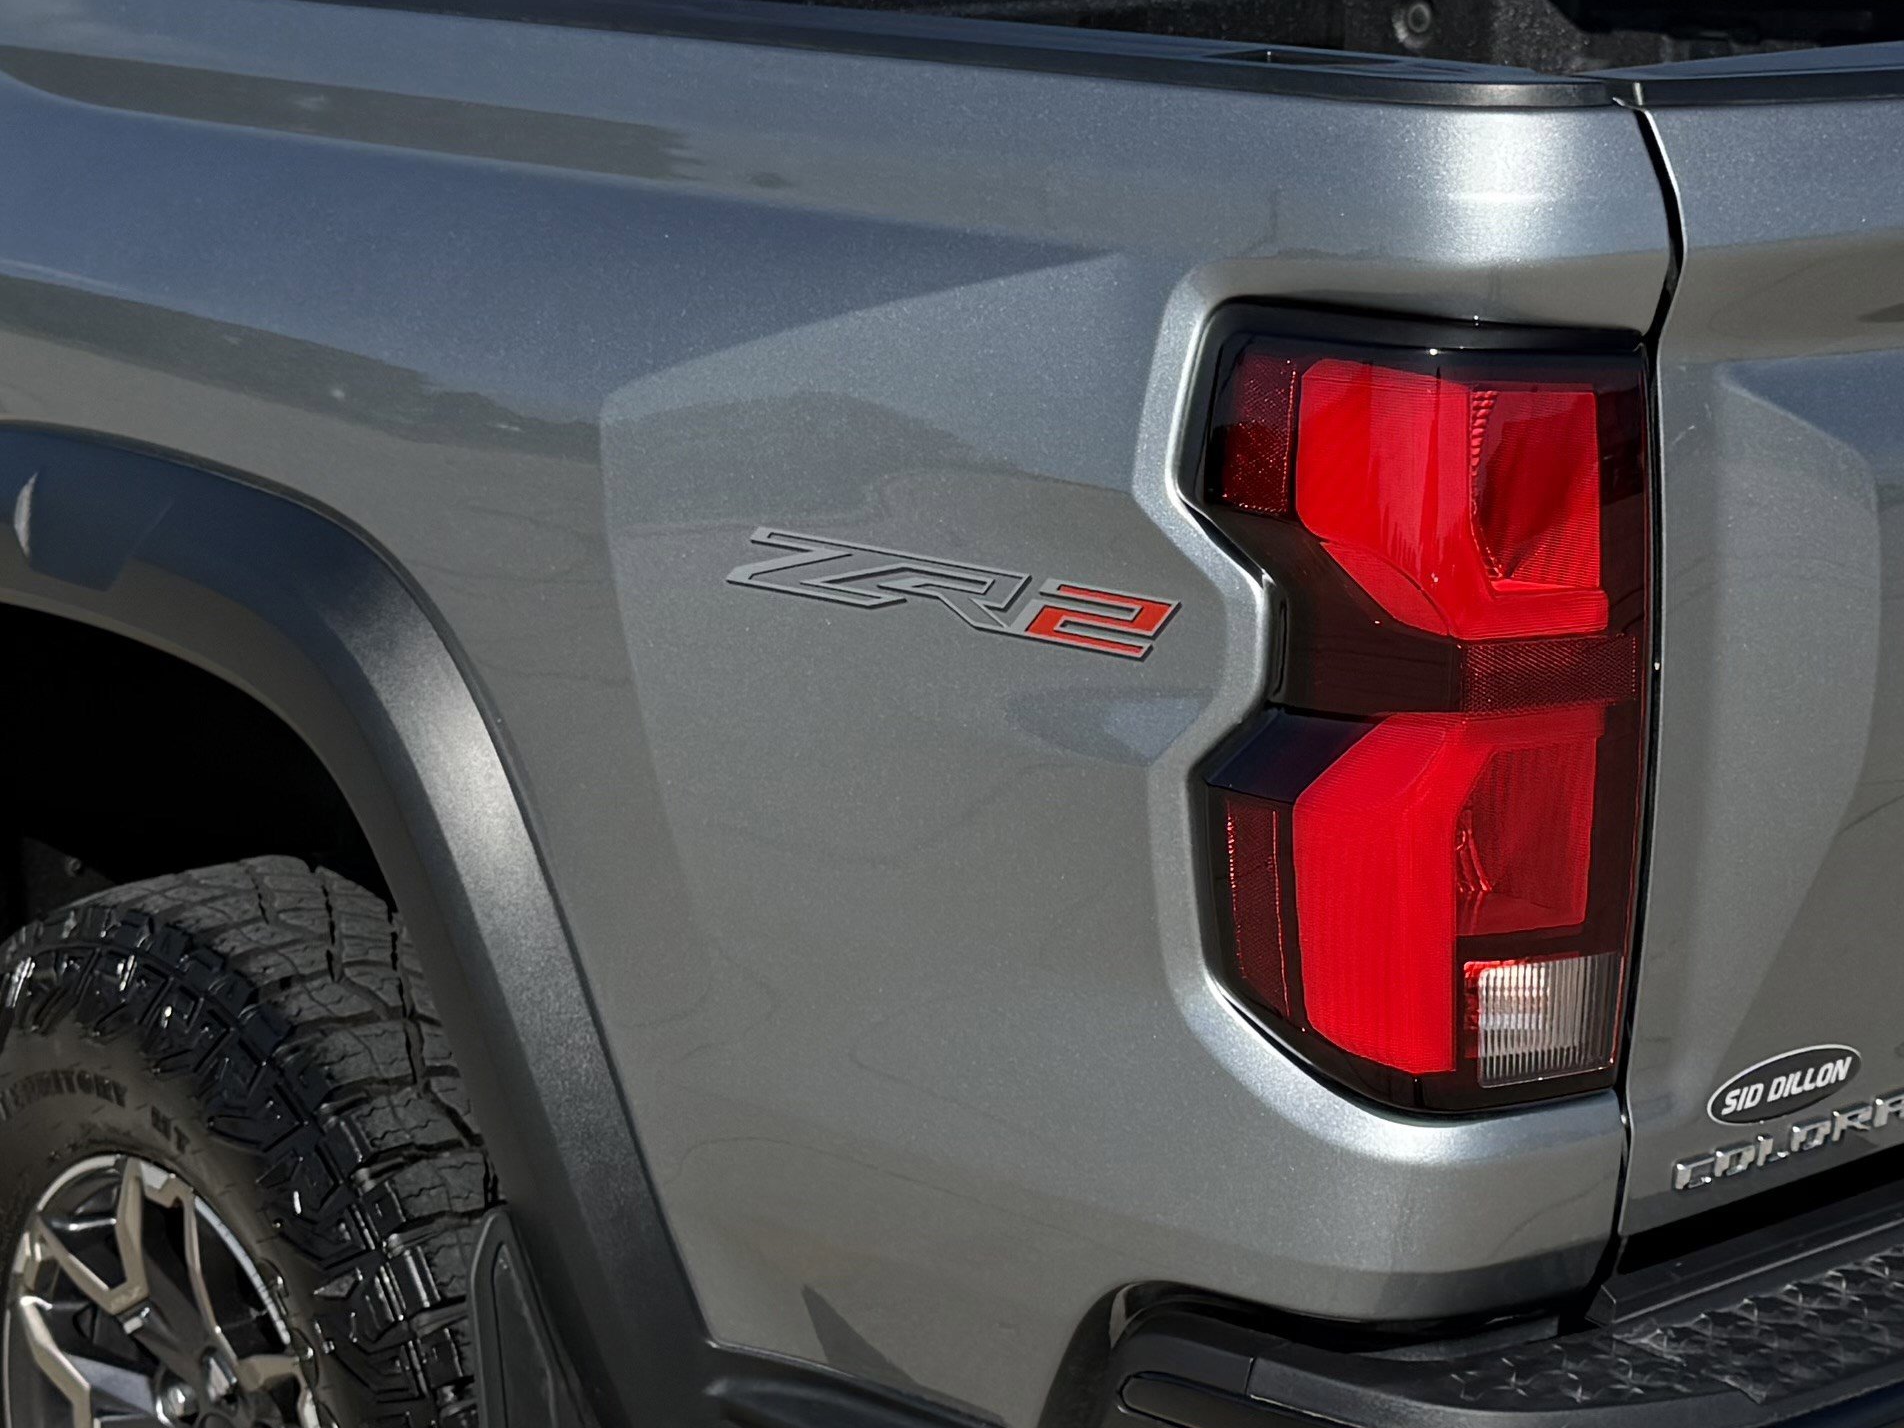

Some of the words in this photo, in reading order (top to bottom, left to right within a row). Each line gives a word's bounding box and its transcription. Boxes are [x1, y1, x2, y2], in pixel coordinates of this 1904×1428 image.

[725, 525, 1182, 662] ZR2
[1721, 1083, 1765, 1116] SID
[1767, 1056, 1852, 1103] DILLON
